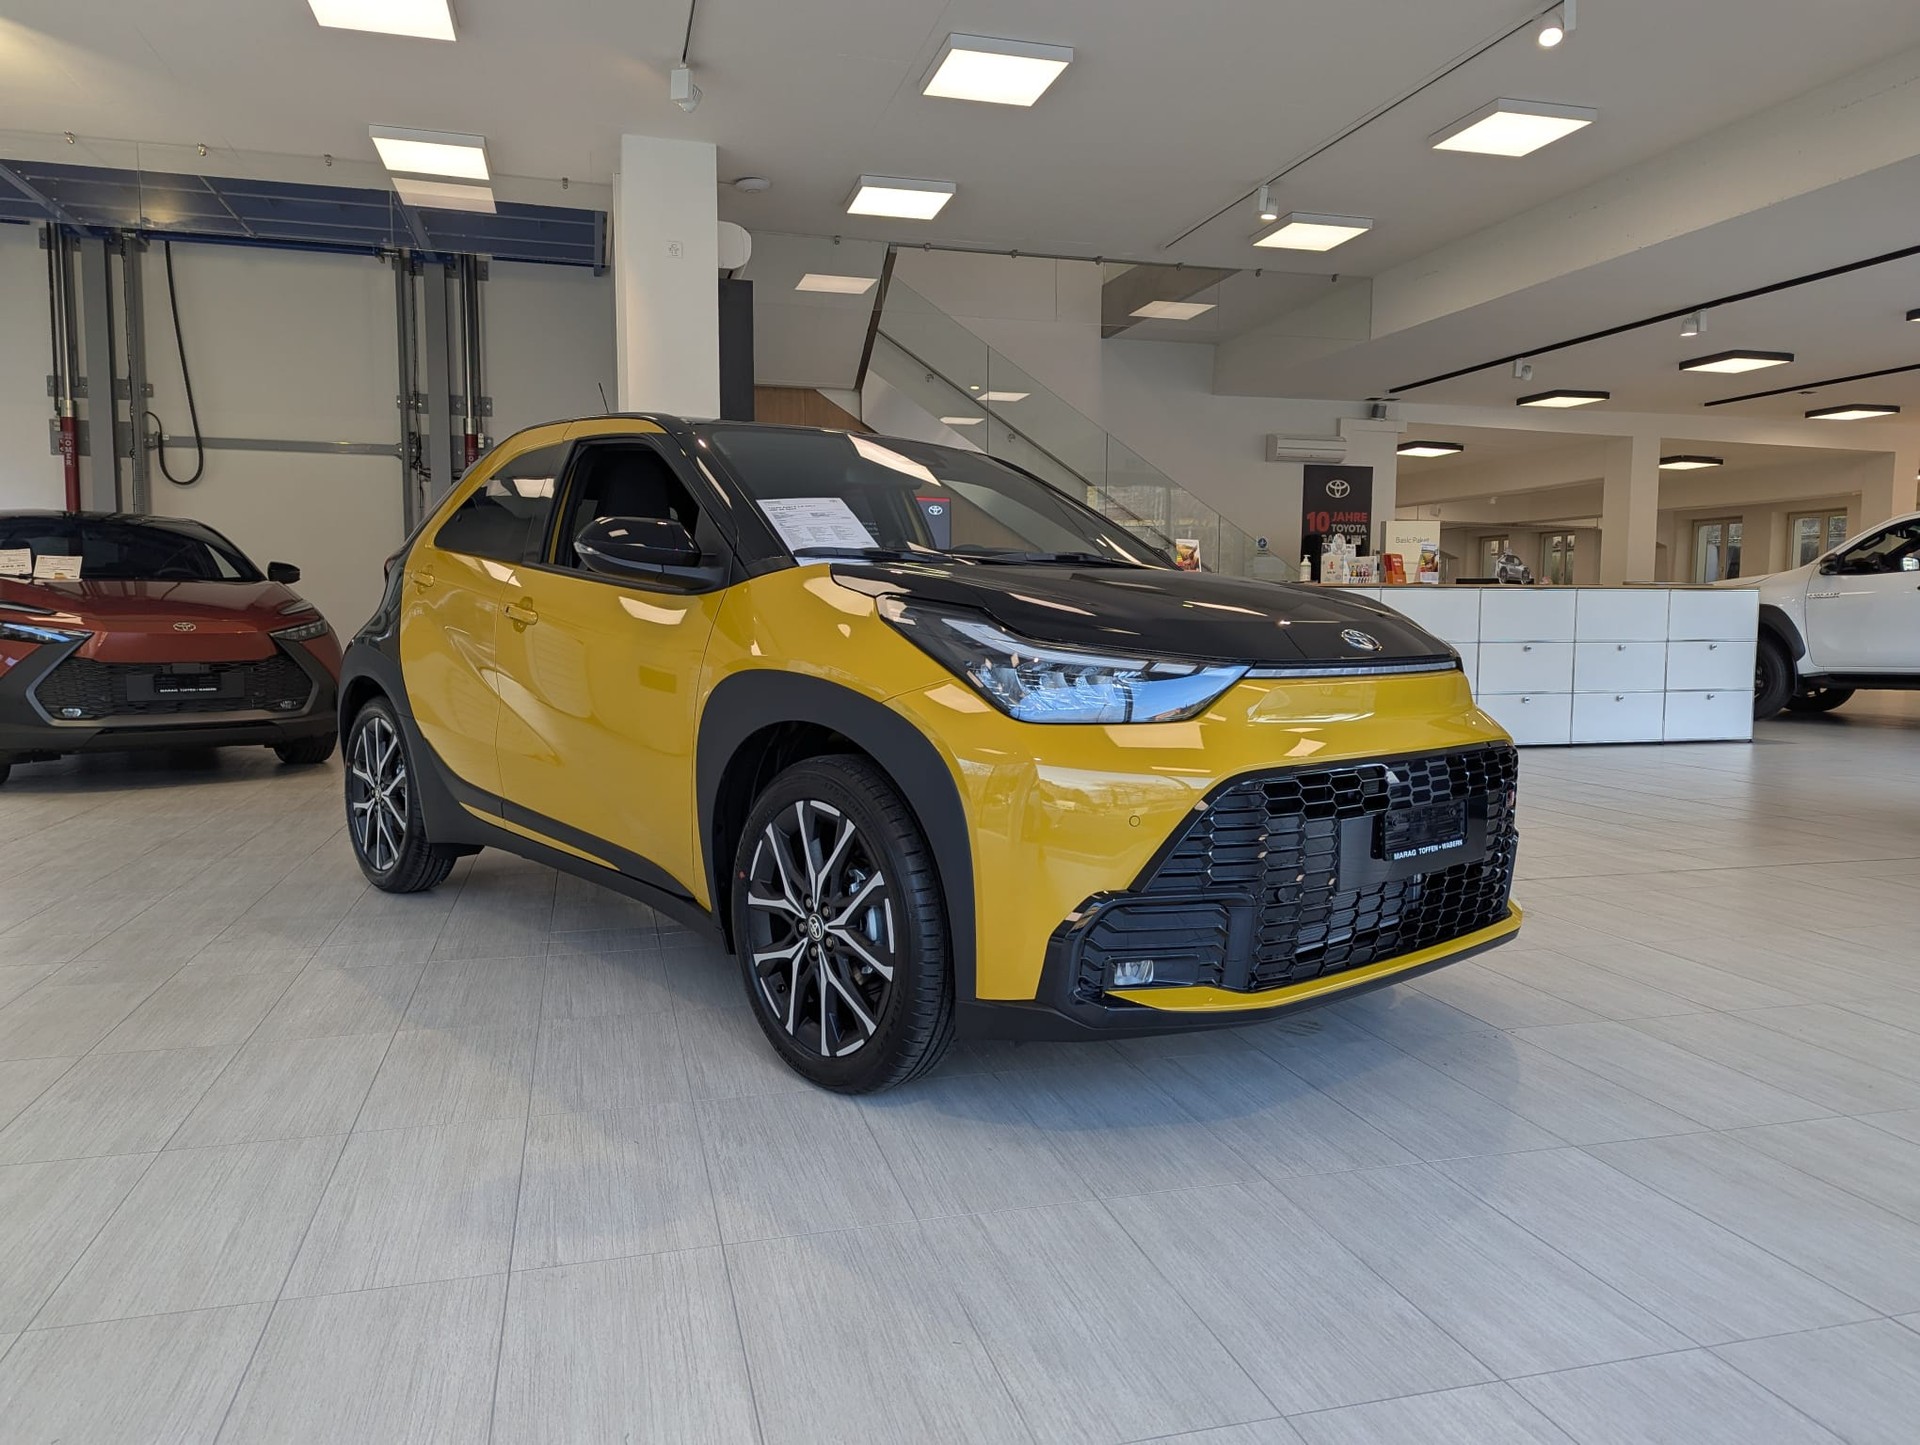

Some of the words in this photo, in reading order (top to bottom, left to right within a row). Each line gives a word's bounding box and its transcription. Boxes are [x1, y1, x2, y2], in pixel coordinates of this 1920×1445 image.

[1307, 511, 1330, 533] 10
[1332, 511, 1368, 522] JAHRE
[1330, 524, 1367, 533] TOYOTA
[1393, 849, 1417, 860] MARAG
[1418, 844, 1439, 855] TOFFEN
[1441, 839, 1463, 850] WABERN
